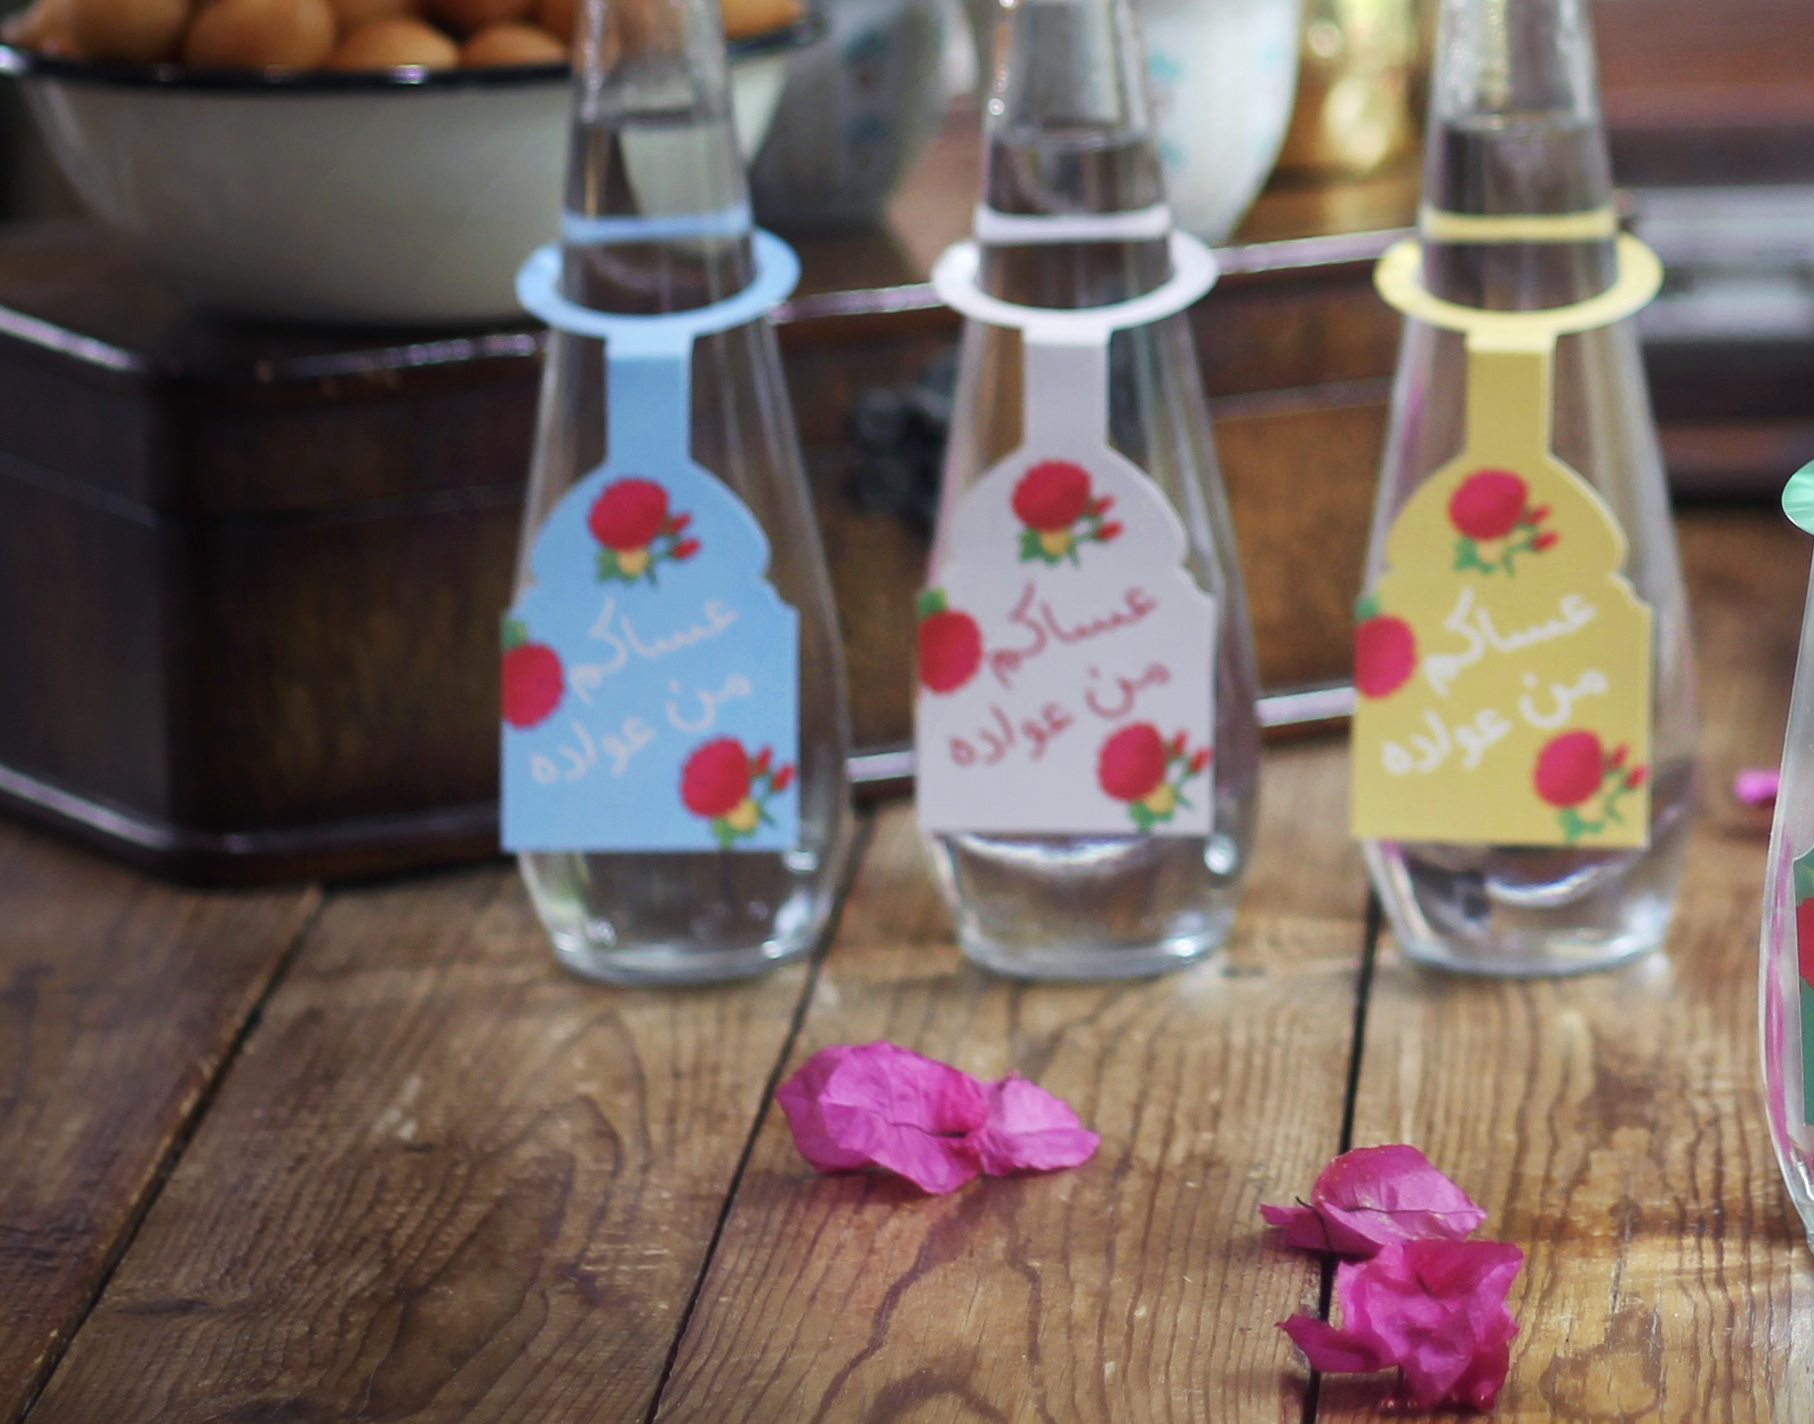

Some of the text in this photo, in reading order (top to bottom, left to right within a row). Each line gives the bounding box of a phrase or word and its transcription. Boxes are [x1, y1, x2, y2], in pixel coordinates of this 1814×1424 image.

[568, 597, 738, 706] عساكم
[986, 579, 1158, 689] عساكم
[1422, 585, 1599, 698] عساكم
[531, 673, 752, 784] من عواده
[949, 661, 1172, 766] من عواده
[1380, 669, 1610, 775] من عواده
